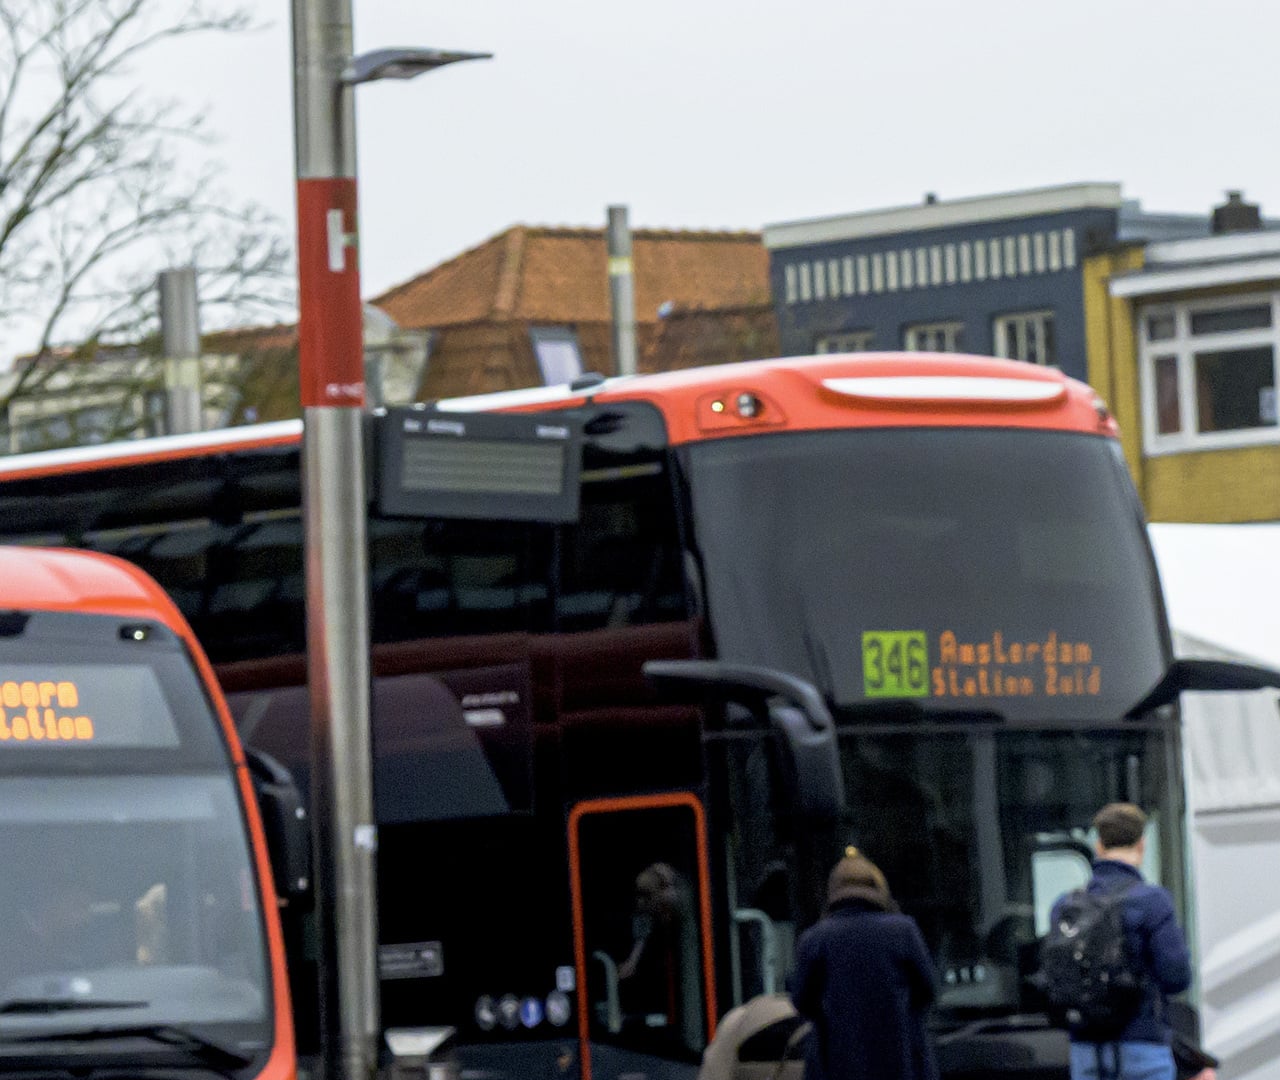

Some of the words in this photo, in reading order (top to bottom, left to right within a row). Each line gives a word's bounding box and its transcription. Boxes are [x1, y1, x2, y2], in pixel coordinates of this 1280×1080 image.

[867, 638, 922, 689] 346
[0, 681, 78, 708] oorn
[933, 667, 1034, 696] Station
[1046, 665, 1100, 696] Zuid
